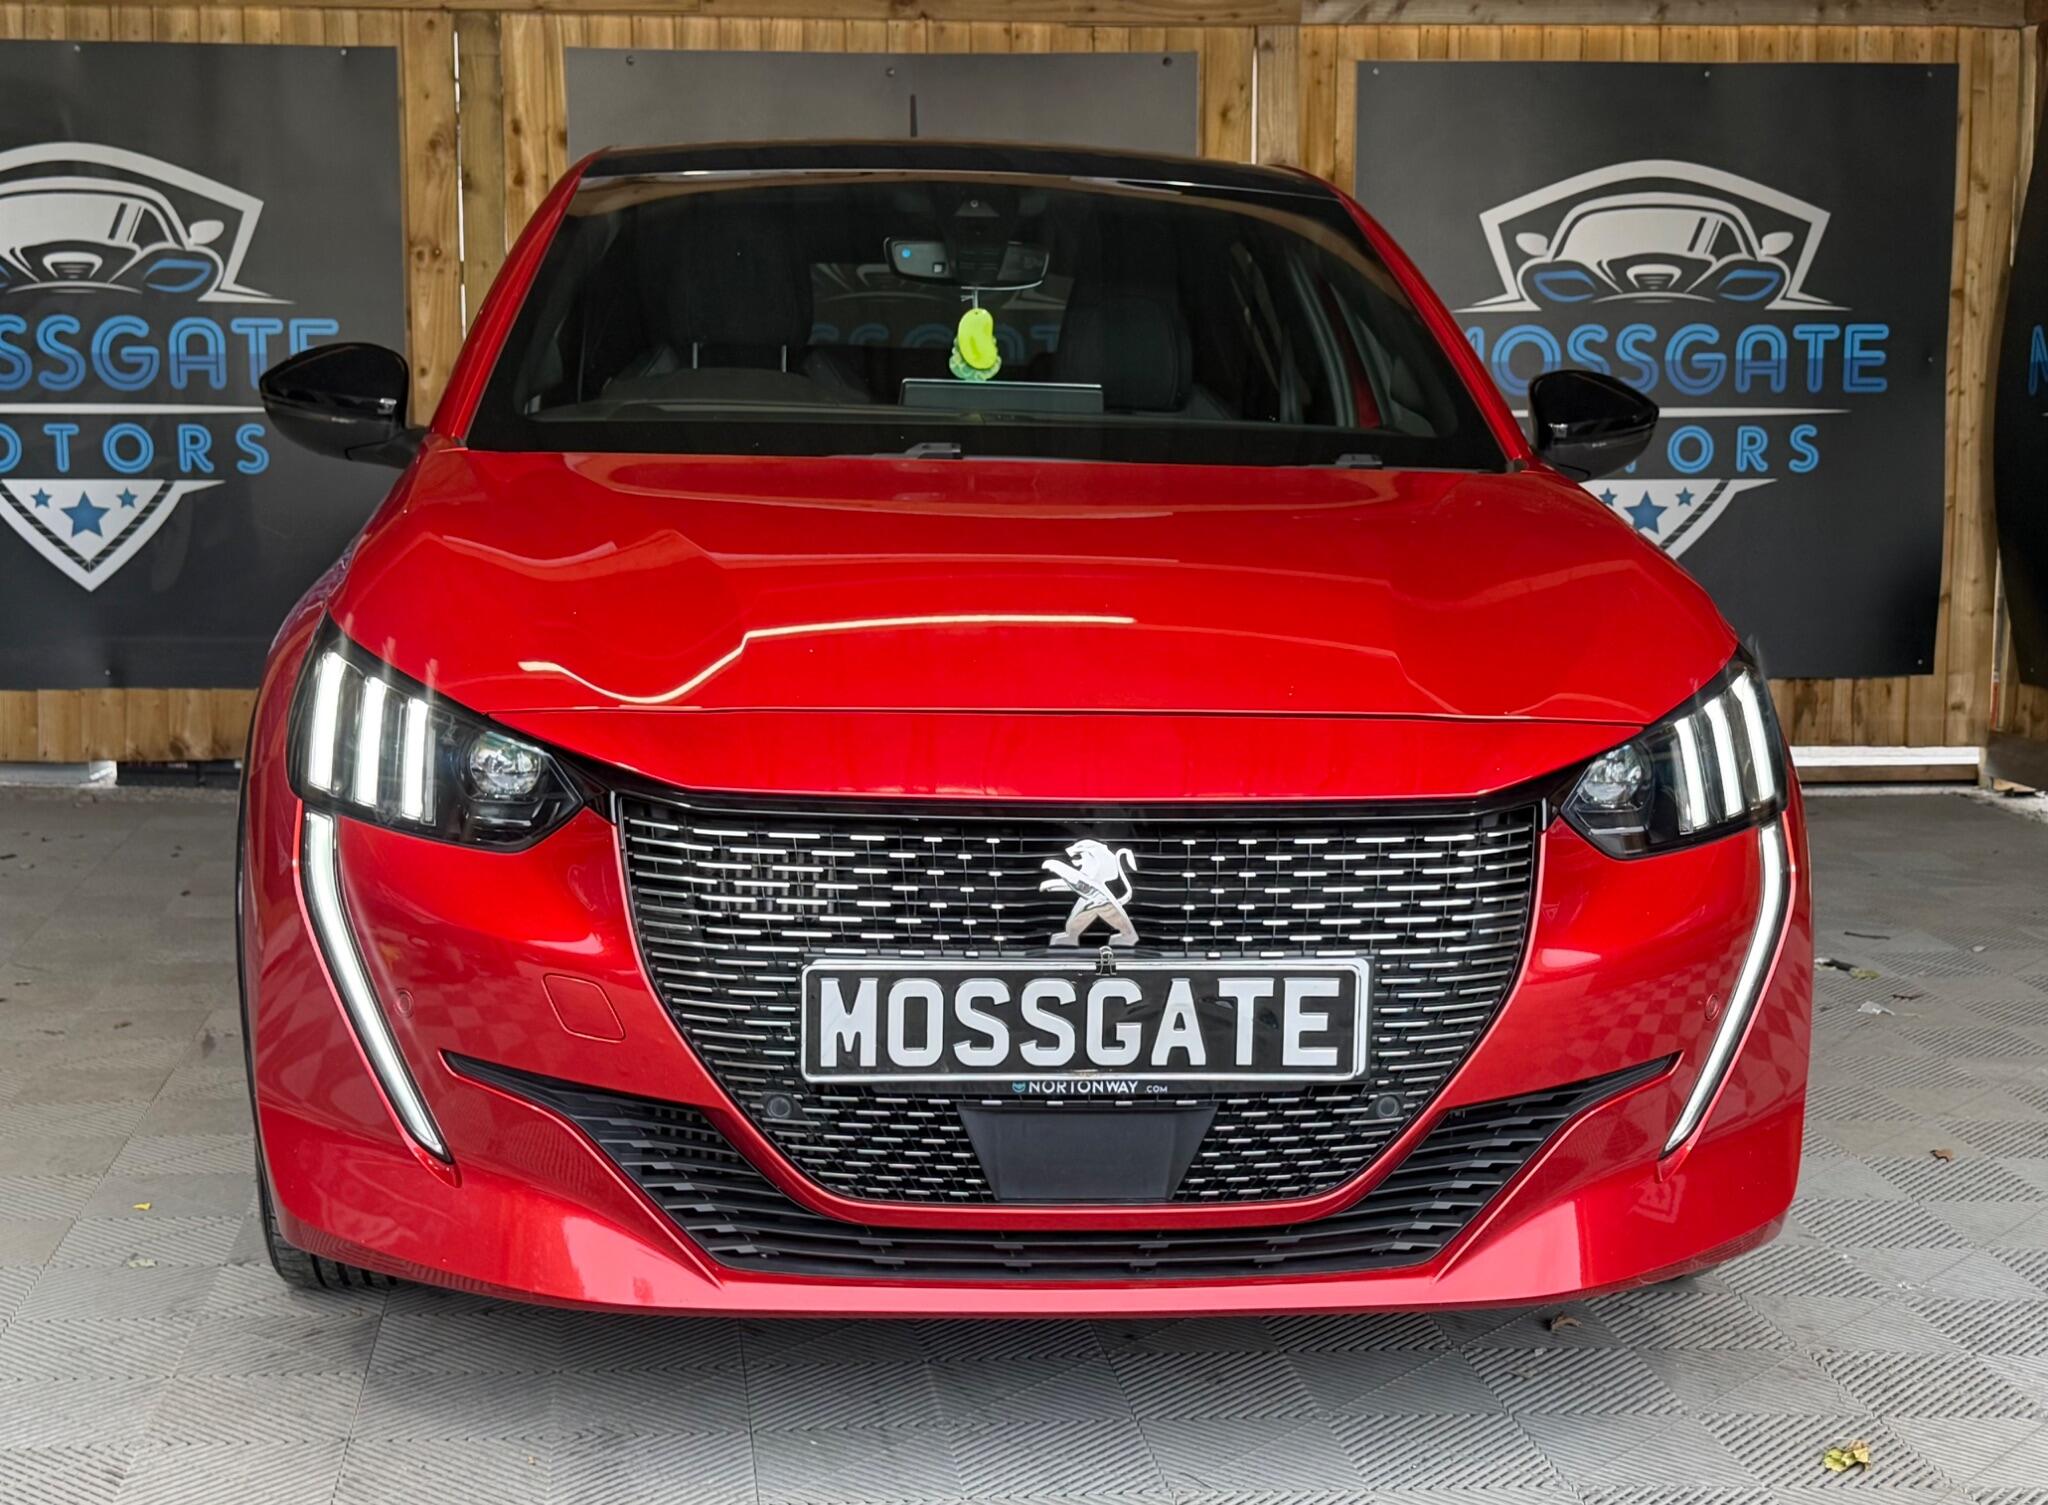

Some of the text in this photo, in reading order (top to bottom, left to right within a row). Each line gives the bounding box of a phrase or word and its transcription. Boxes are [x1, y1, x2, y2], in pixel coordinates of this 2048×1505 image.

[1464, 323, 1890, 397] OSSGATE
[820, 977, 1340, 1068] MOSSGATE
[1028, 1080, 1139, 1094] NORTONWAY
